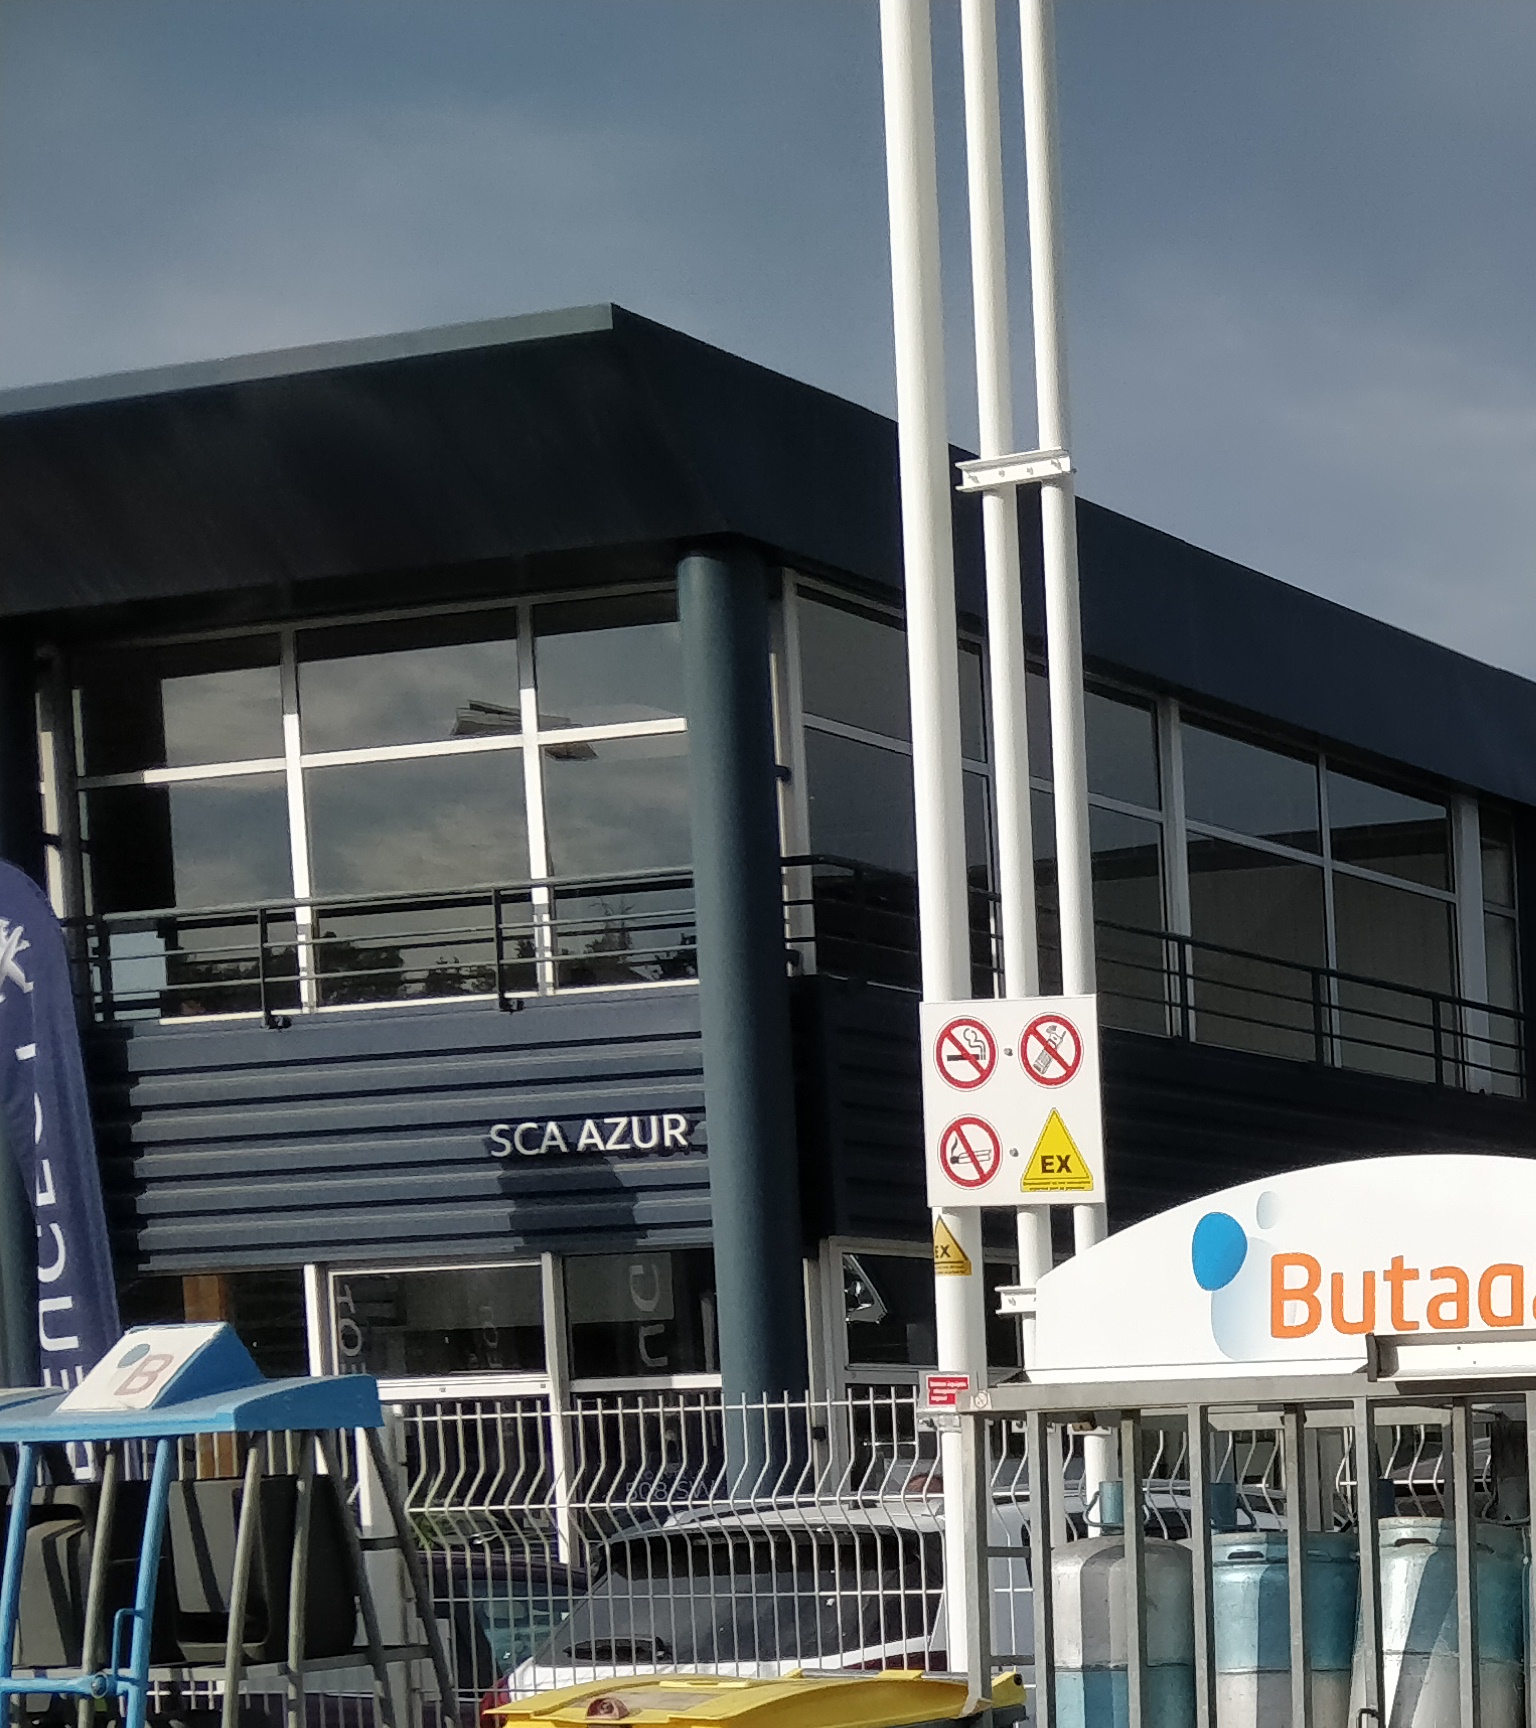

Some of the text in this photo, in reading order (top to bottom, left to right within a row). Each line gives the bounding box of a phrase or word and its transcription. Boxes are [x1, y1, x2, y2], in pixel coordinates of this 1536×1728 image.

[489, 1113, 689, 1157] SCA AZUR
[1041, 1154, 1072, 1174] EX
